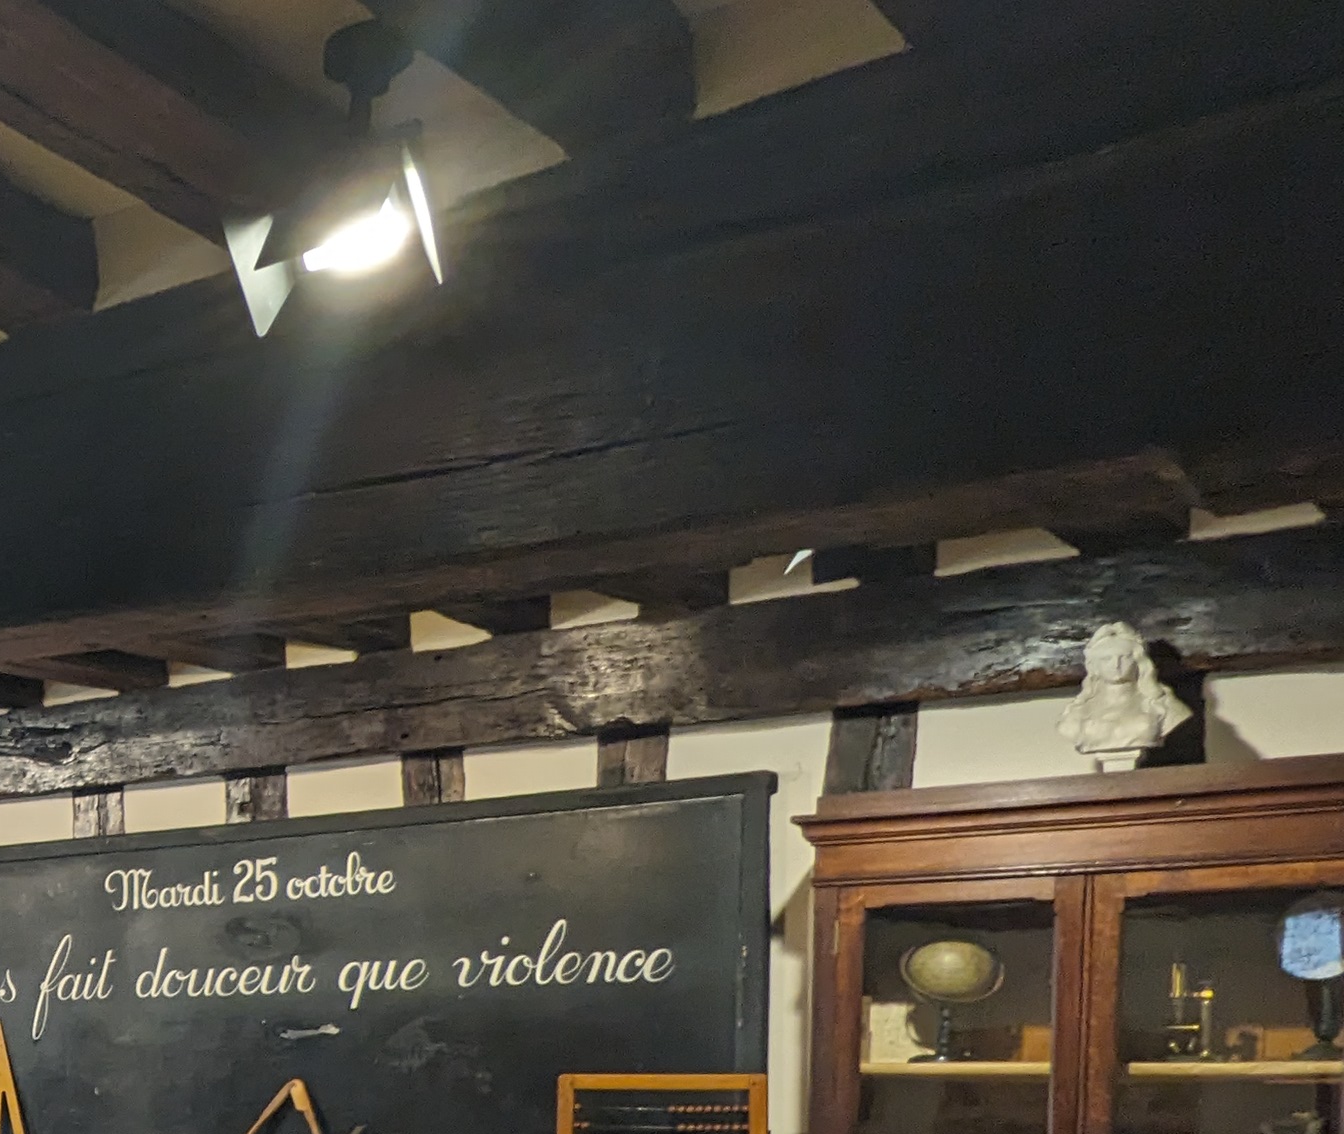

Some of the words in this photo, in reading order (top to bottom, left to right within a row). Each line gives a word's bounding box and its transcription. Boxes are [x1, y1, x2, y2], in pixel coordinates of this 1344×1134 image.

[105, 868, 225, 911] Mardi
[232, 856, 279, 904] 25
[286, 850, 398, 900] octobre
[30, 933, 117, 1041] fait
[134, 946, 317, 999] douceur
[337, 957, 430, 1010] que
[452, 918, 676, 988] violence
